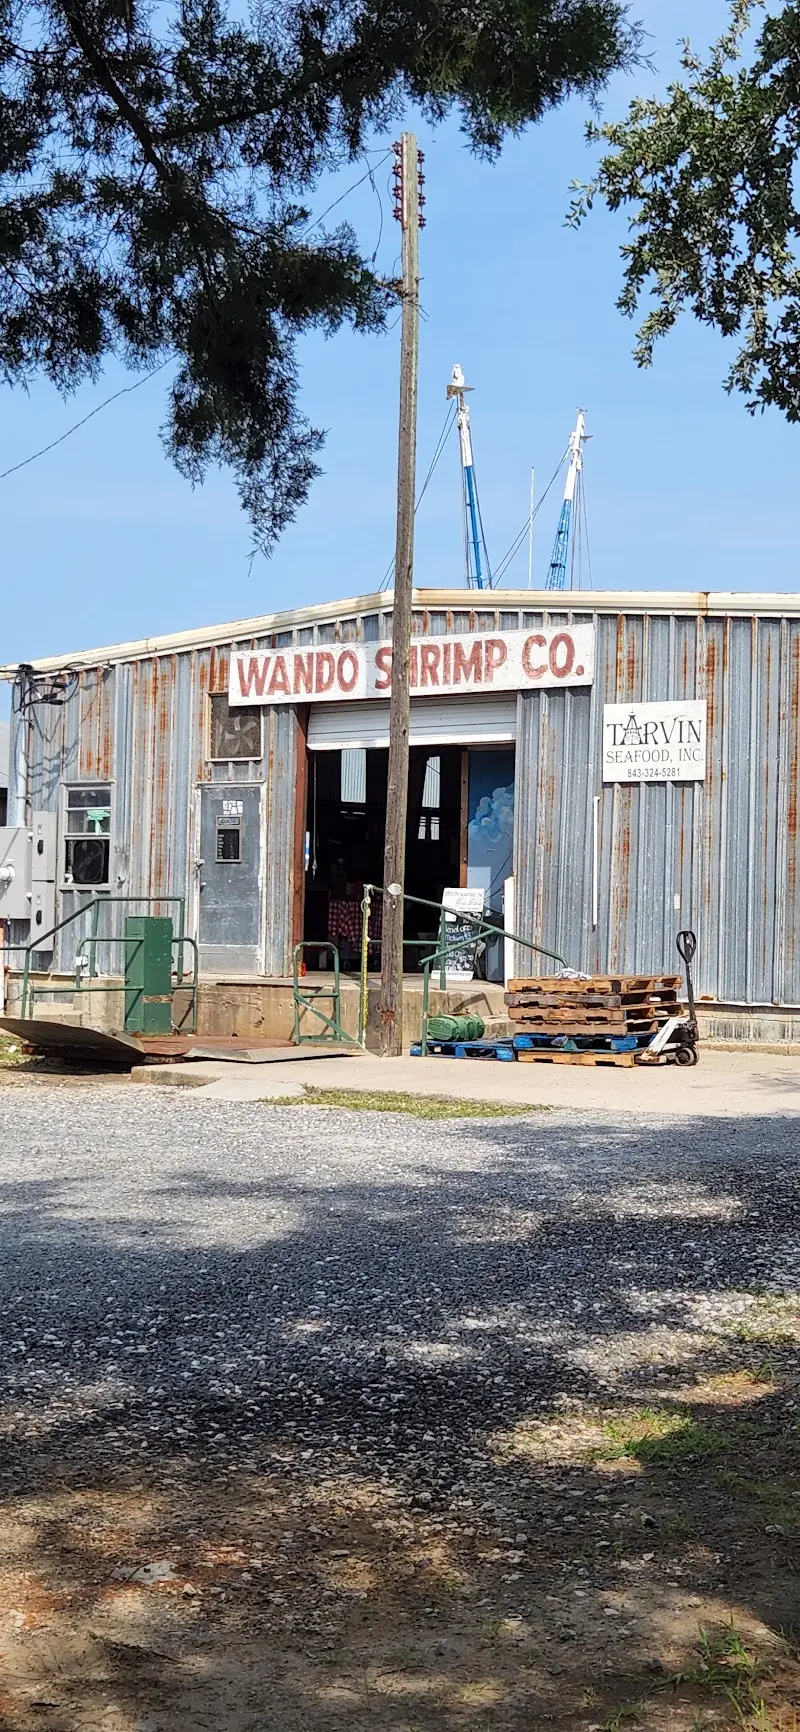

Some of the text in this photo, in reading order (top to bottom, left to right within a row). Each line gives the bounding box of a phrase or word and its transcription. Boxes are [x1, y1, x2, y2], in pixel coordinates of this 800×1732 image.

[237, 650, 359, 698] WANDO
[521, 632, 585, 680] CO.
[606, 709, 702, 747] TARVIN
[606, 748, 704, 764] SEAFOOD, INC.
[627, 767, 680, 778] 843-324-5281
